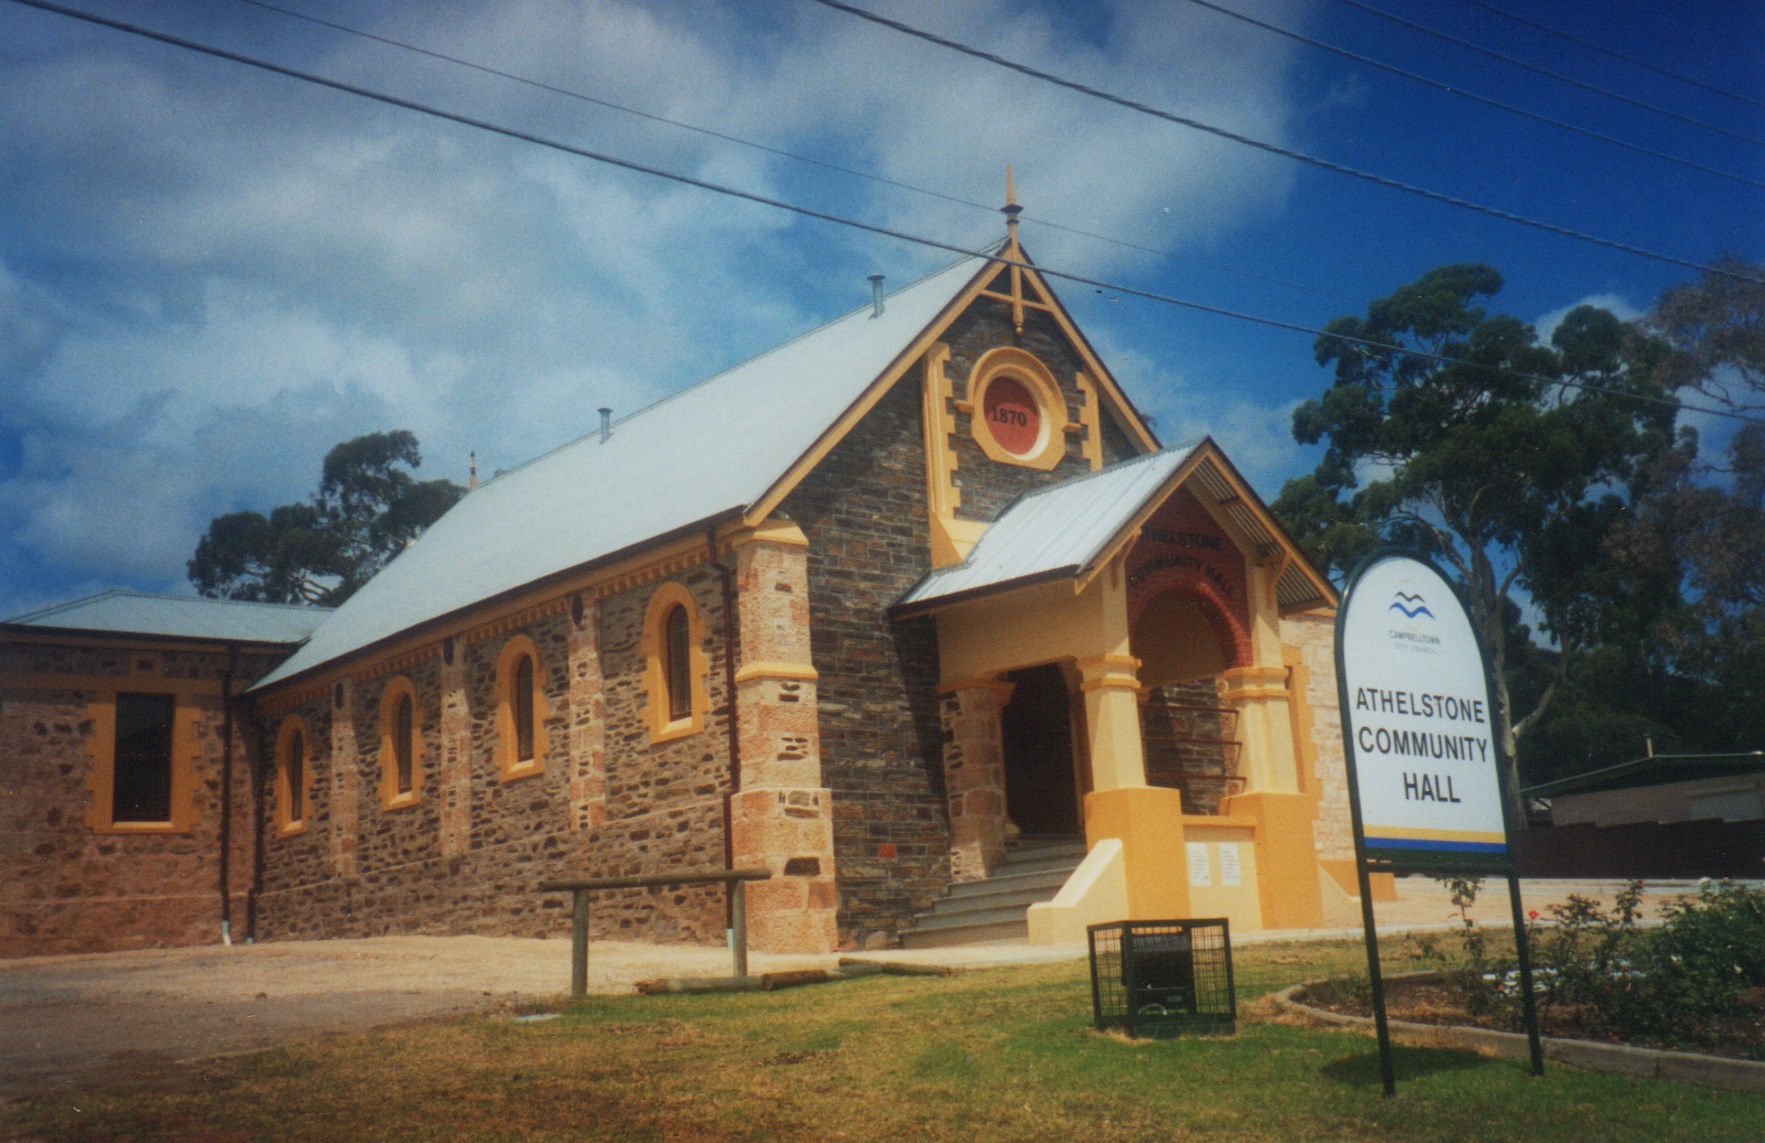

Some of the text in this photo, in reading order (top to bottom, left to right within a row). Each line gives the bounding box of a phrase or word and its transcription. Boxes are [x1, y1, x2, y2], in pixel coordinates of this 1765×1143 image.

[992, 406, 1027, 427] 1870
[1389, 630, 1440, 644] CAMPBELLTOWN
[1356, 687, 1485, 723] ATHELSTONE
[1359, 726, 1487, 762] COMMUNITY
[1403, 772, 1461, 803] HALL
